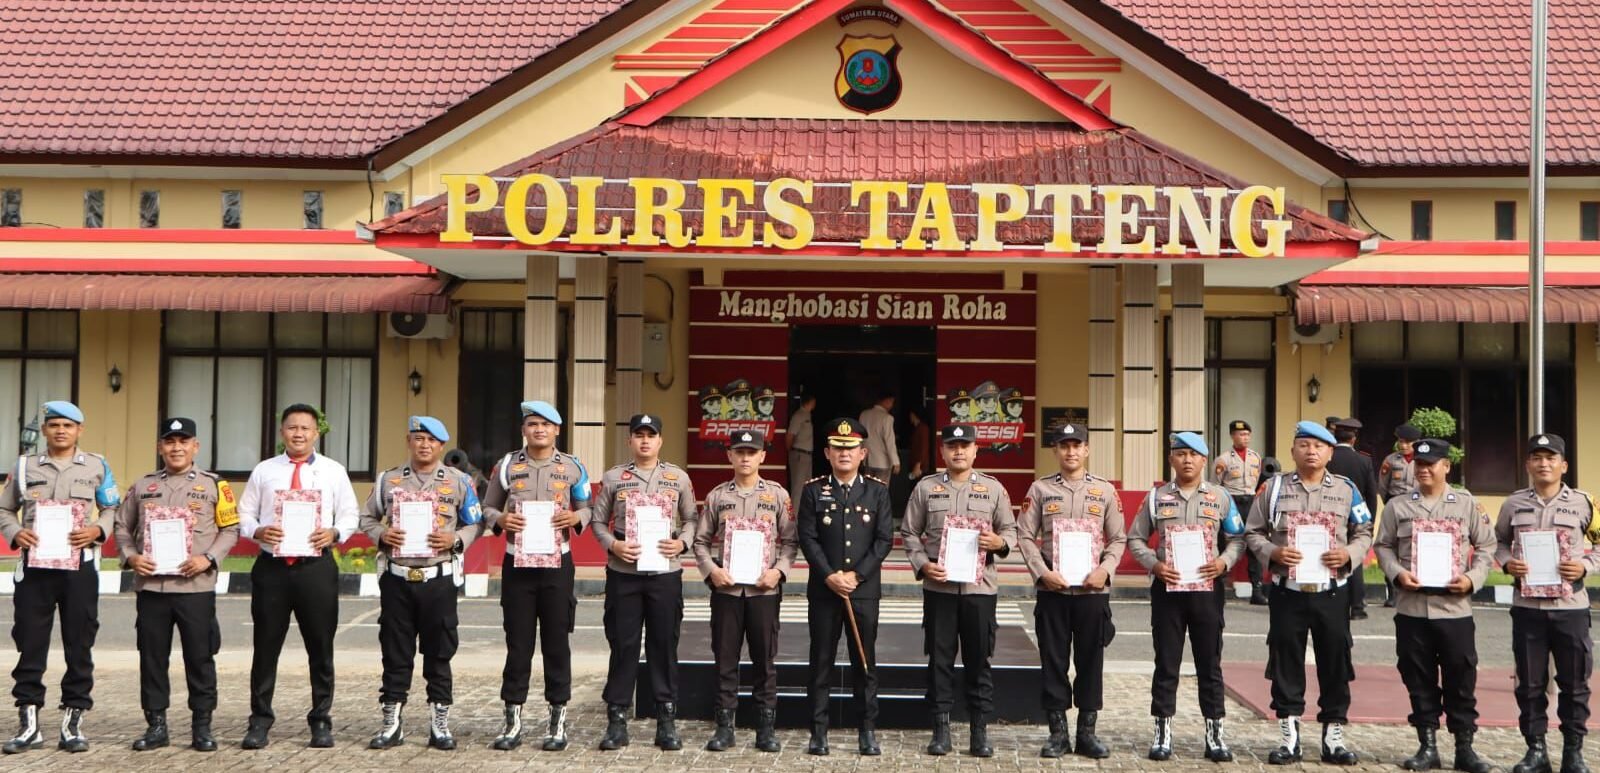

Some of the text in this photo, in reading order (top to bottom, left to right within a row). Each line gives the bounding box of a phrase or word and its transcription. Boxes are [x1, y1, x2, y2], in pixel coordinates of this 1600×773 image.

[841, 9, 898, 23] SUMATERA UTARA
[440, 173, 1293, 257] POLRES TAPTENG
[719, 291, 1007, 321] Manghobasi Sian Roha
[975, 425, 1019, 439] ESISI
[550, 473, 569, 482] POLRI
[658, 480, 680, 488] POLRI
[187, 492, 208, 500] POLRI
[1085, 495, 1105, 503] POLRI
[757, 503, 776, 511] POLRI
[1199, 501, 1220, 509] POLRI
